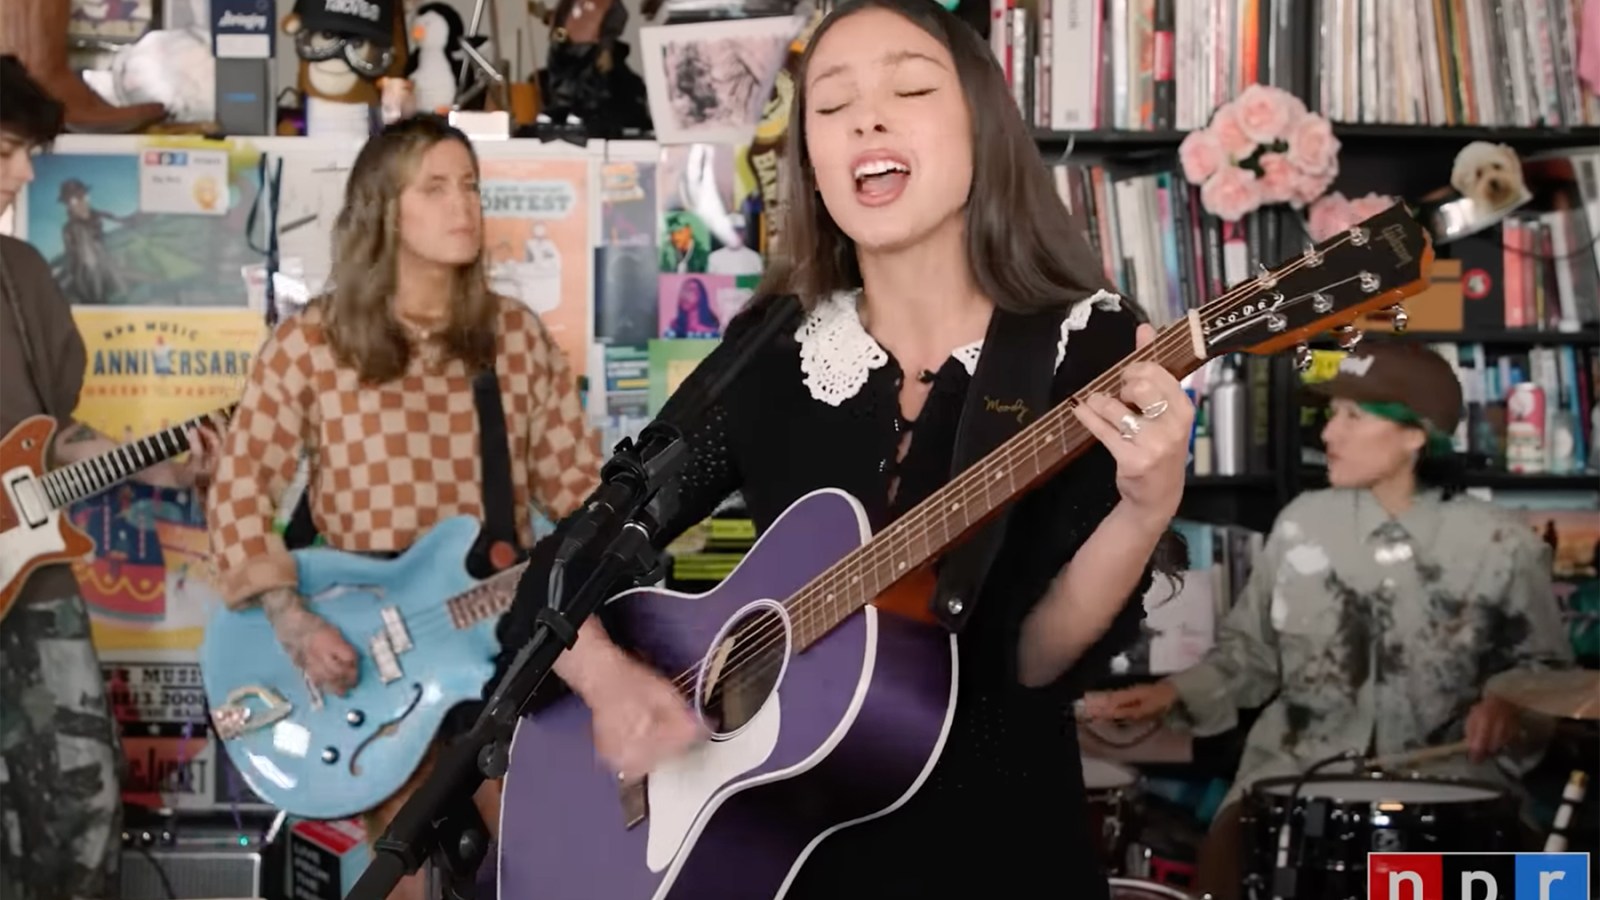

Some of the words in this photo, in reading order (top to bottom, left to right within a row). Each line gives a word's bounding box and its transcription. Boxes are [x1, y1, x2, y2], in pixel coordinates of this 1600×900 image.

[481, 194, 571, 212] ONTEST
[145, 322, 199, 341] MUSIC
[83, 386, 148, 397] ONCERT
[142, 668, 203, 683] MUSI
